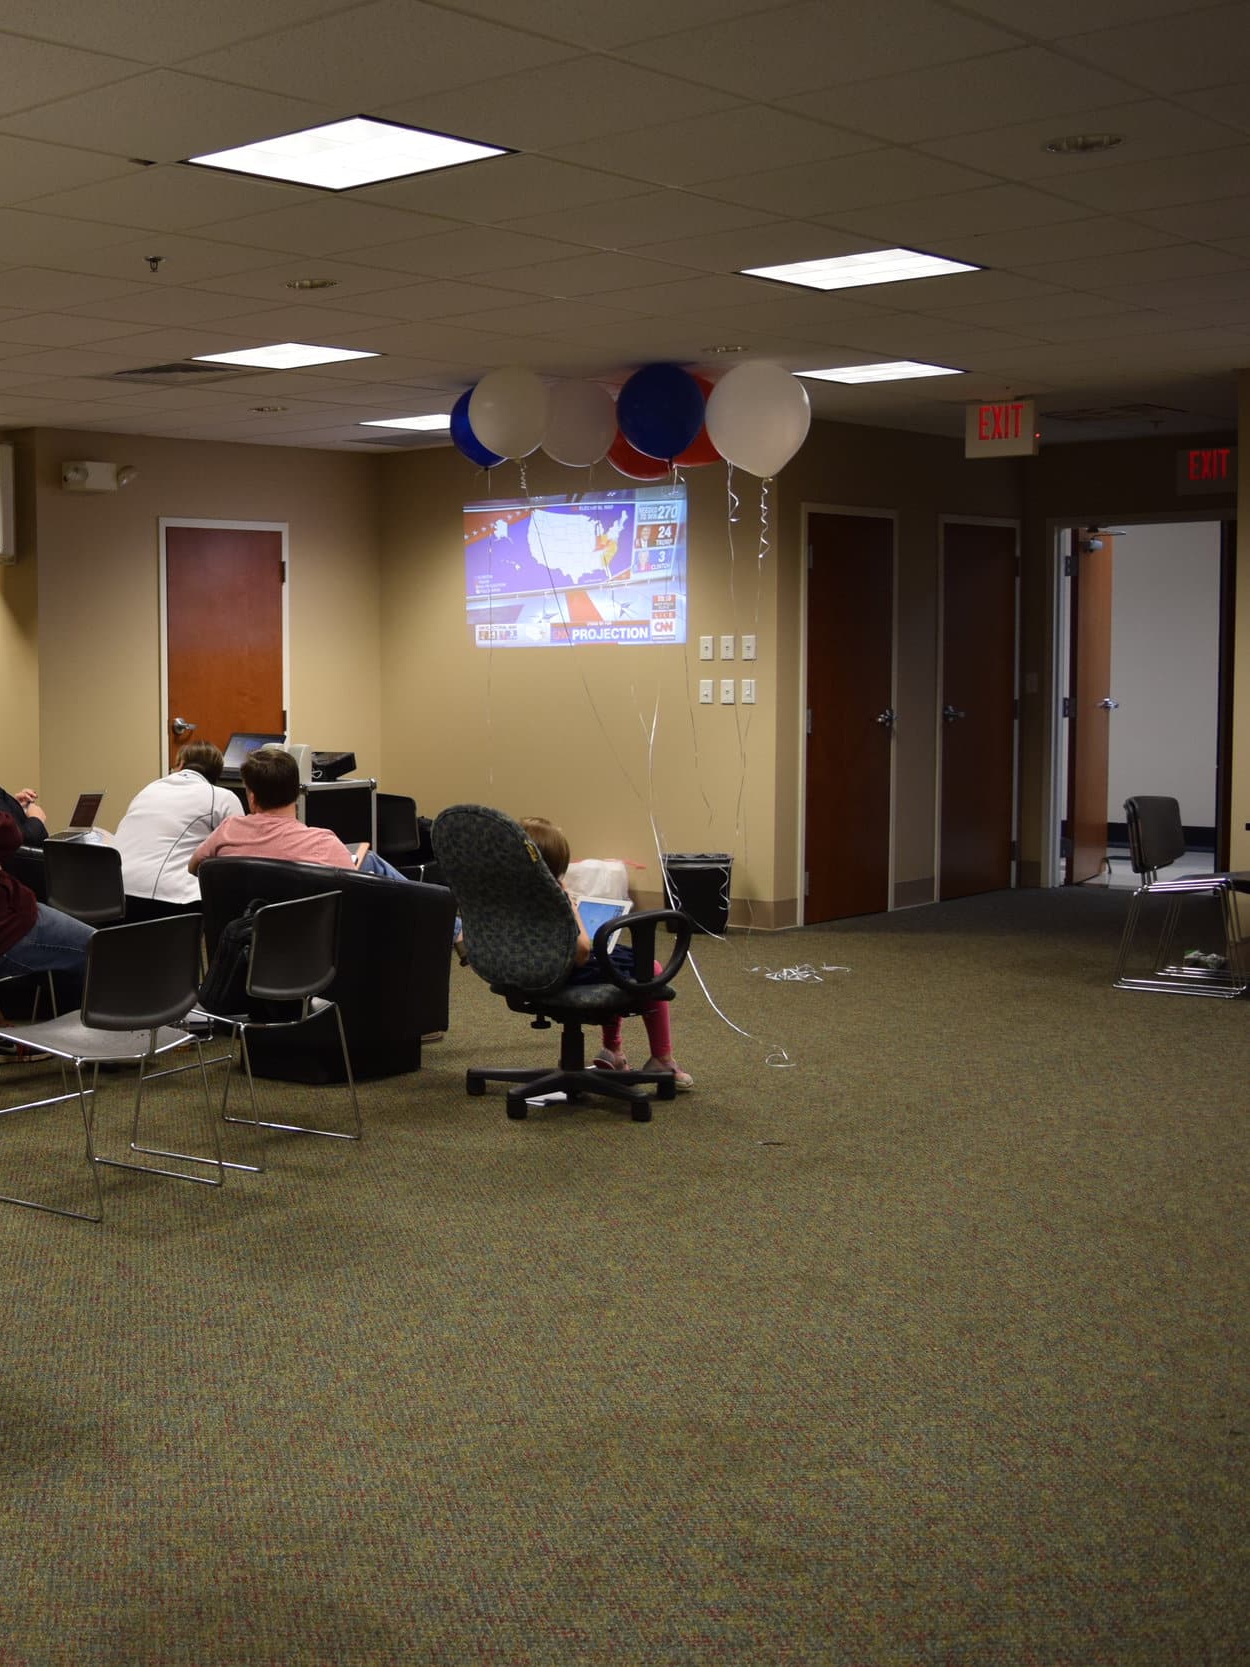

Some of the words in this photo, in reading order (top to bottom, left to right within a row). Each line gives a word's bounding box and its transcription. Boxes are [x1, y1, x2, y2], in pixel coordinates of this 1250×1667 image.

[978, 403, 1023, 440] EXIT
[1188, 448, 1230, 480] EXIT
[658, 505, 677, 519] 270
[658, 526, 671, 538] 24
[657, 551, 666, 563] 3
[572, 627, 648, 640] PROJECTION
[654, 622, 673, 632] CNN
